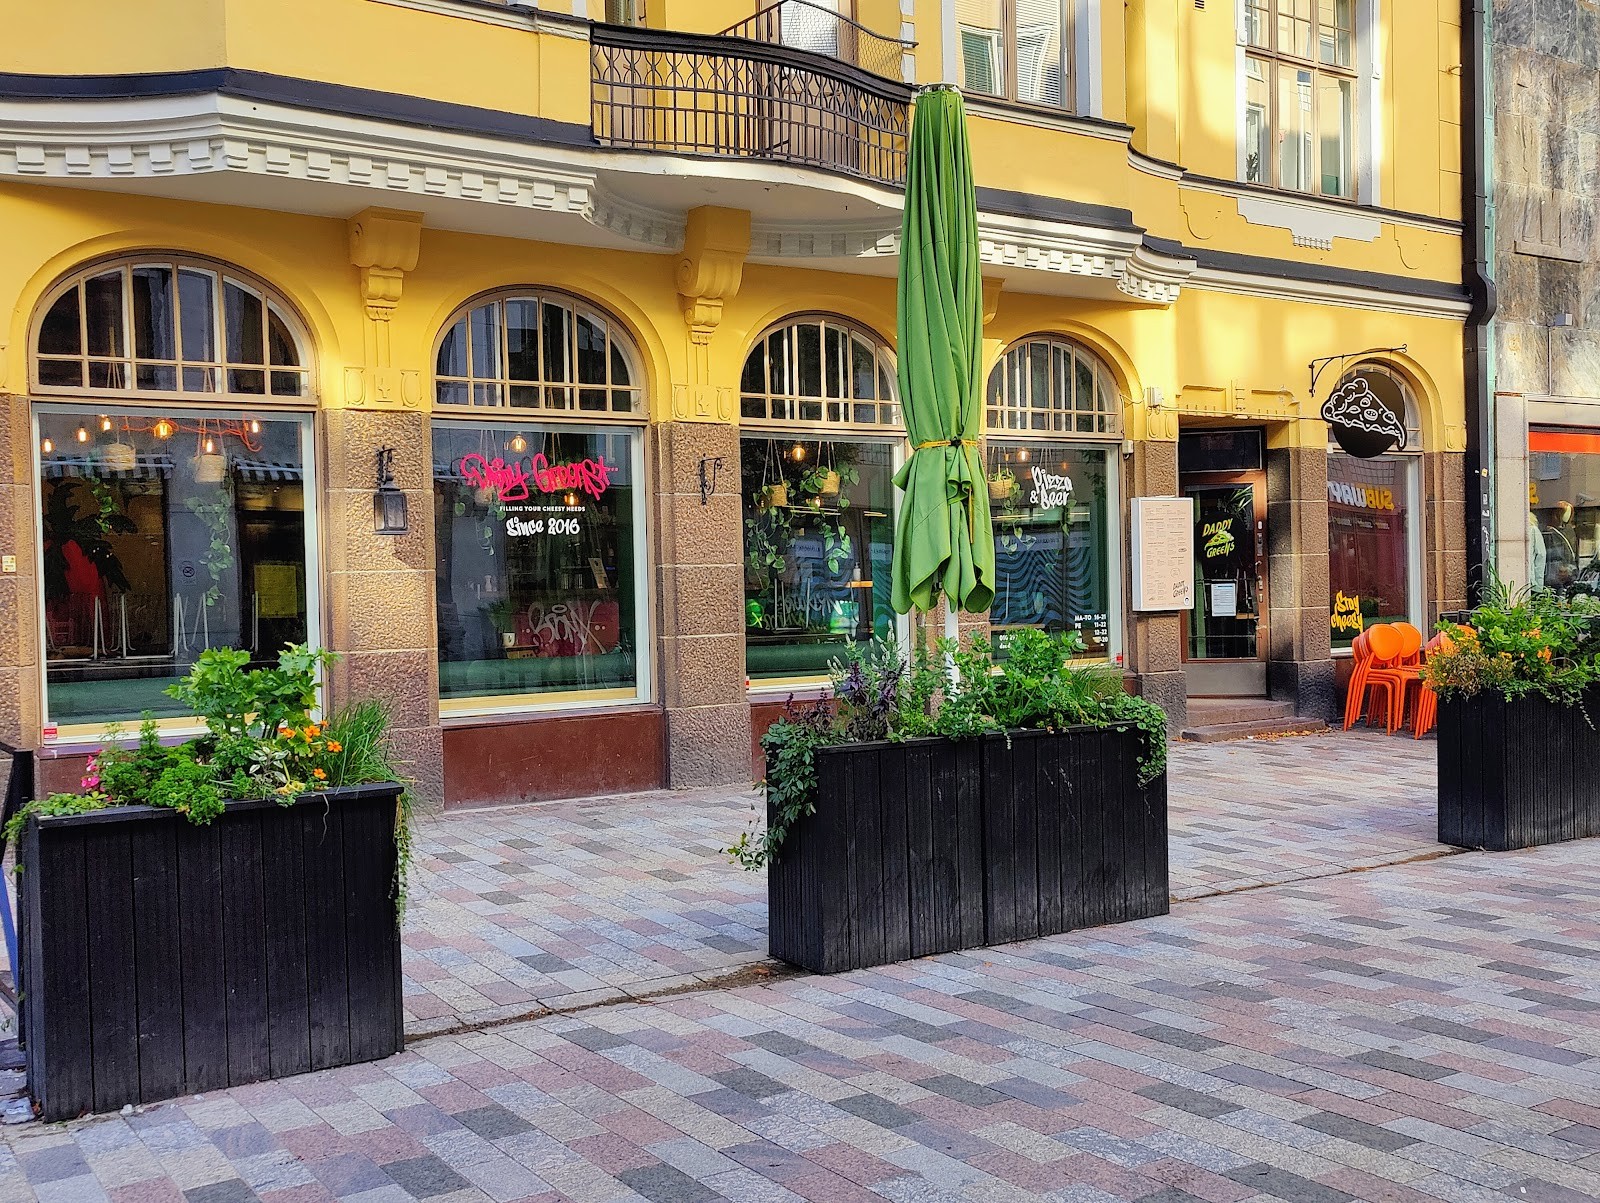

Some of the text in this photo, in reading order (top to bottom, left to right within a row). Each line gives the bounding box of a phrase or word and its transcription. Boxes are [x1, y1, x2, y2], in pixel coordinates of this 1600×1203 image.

[1031, 466, 1073, 495] Pizza
[1030, 483, 1070, 510] & Beer
[506, 516, 580, 537] Since 2016
[1202, 518, 1233, 538] DADDY
[1336, 590, 1360, 616] Stay
